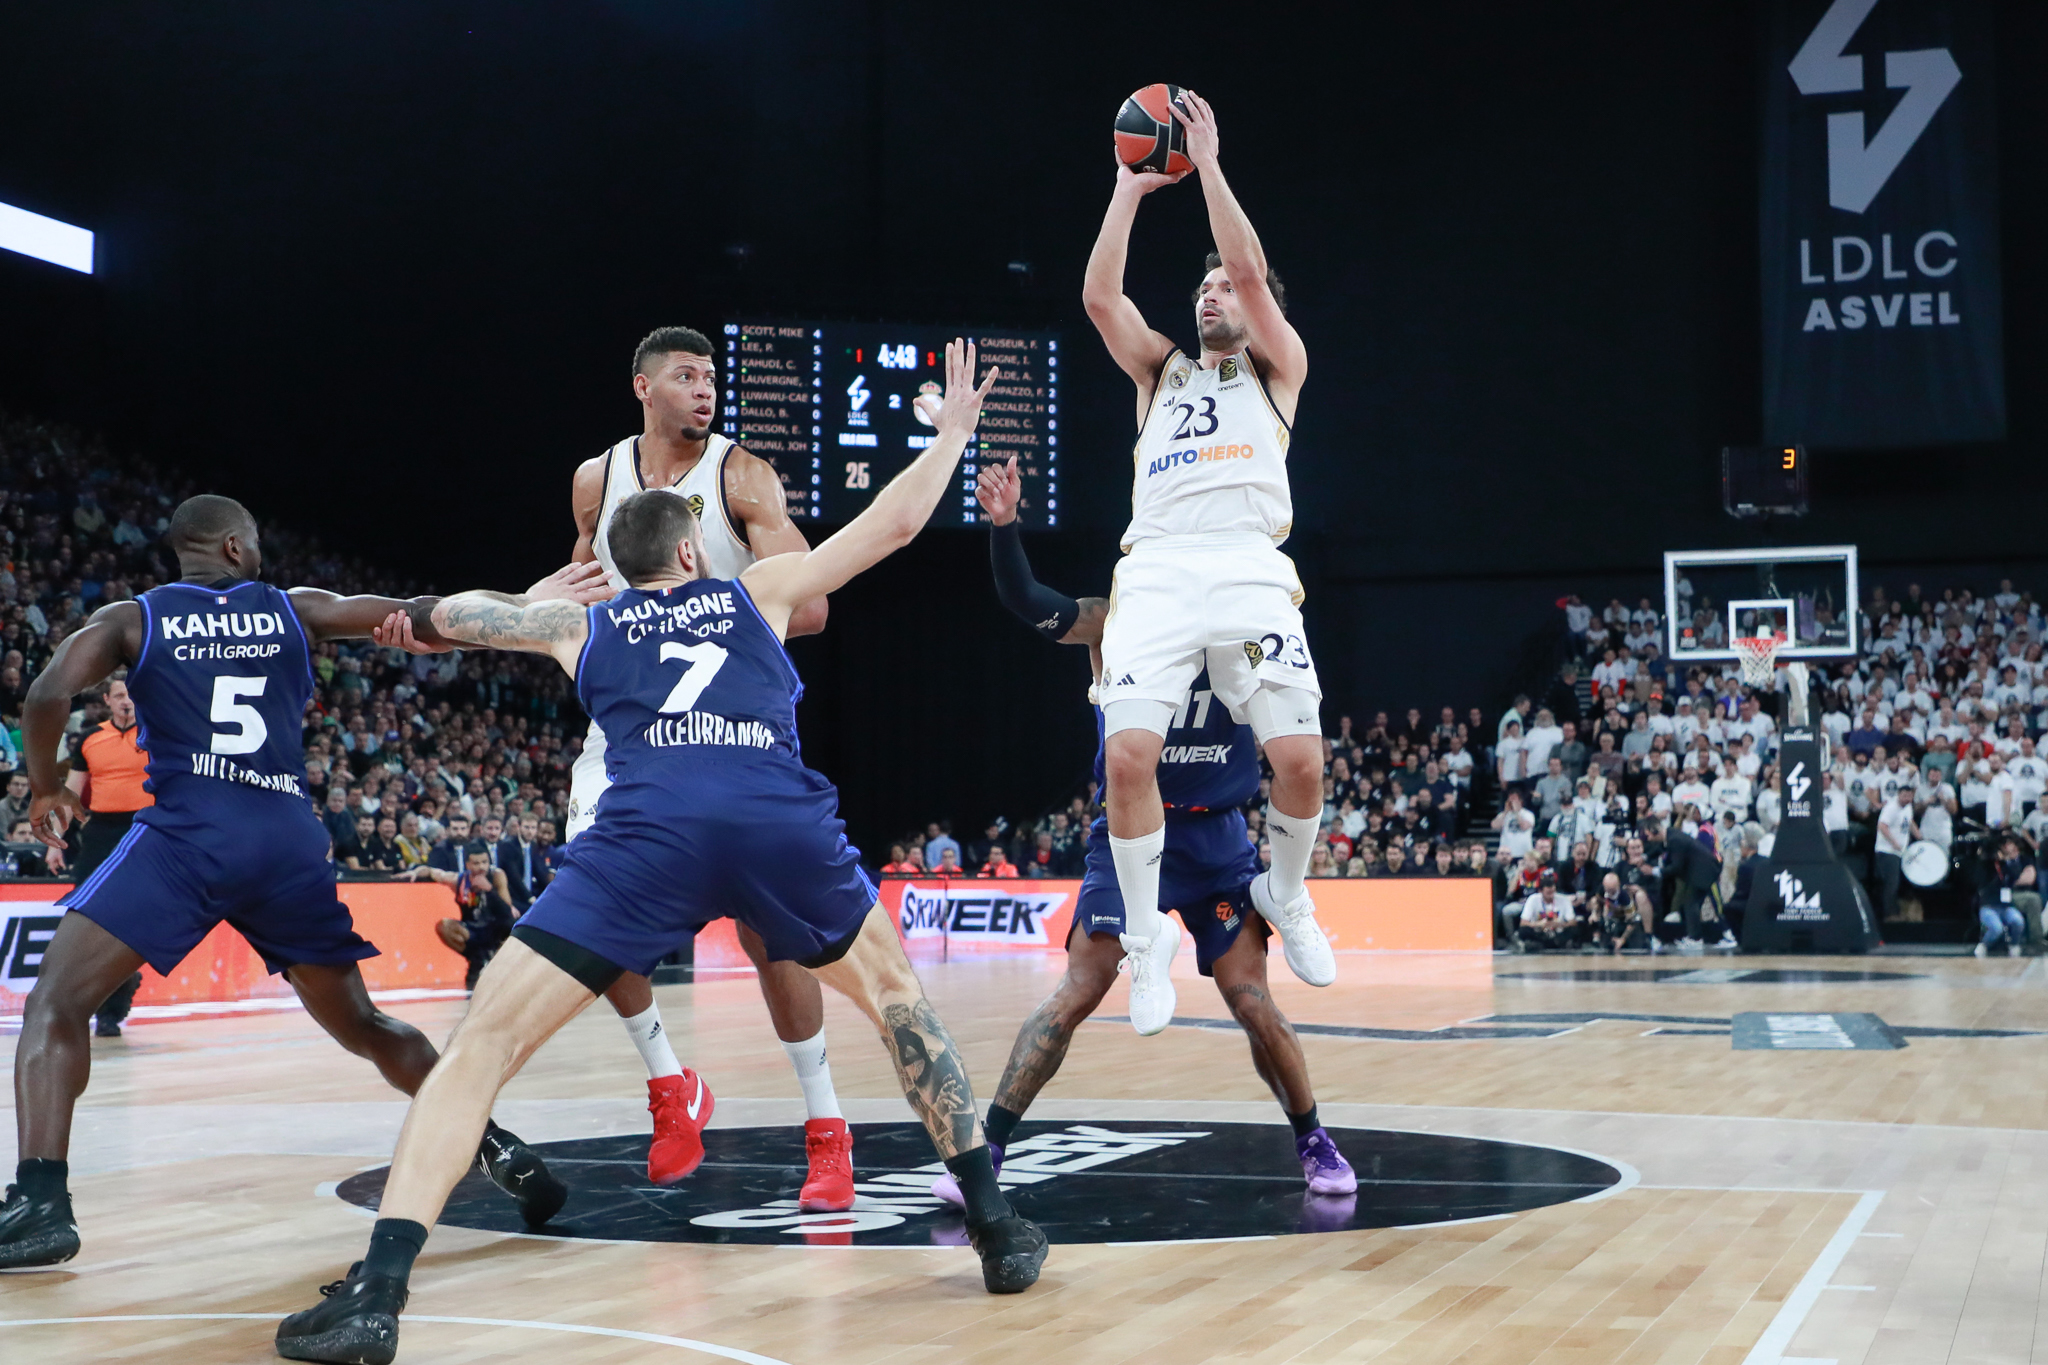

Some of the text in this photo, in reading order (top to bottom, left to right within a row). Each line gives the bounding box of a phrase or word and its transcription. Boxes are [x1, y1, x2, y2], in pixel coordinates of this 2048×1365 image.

[1800, 231, 1958, 285] LDLC
[1802, 291, 1960, 332] ASVEL
[723, 324, 822, 339] 00 SCOTT, MIKE 4
[727, 341, 736, 351] 3
[741, 342, 764, 353] LEE,
[813, 345, 822, 356] 5
[980, 337, 1028, 350] CAUSEUR,
[1048, 341, 1057, 351] 5
[877, 343, 917, 369] 4:43
[980, 354, 1020, 366] DIAGNE,
[1048, 356, 1057, 367] 0
[727, 357, 736, 368] 5
[741, 358, 784, 370] KAHUDI,
[813, 361, 822, 372] 2
[727, 373, 736, 383] 7
[812, 377, 822, 388] 4
[1048, 372, 1057, 383] 3
[726, 389, 735, 400] 9
[812, 393, 821, 404] 6
[1048, 388, 1057, 399] 2
[889, 395, 902, 409] 2
[1048, 404, 1057, 414] 0
[723, 405, 738, 416] 10
[812, 409, 821, 420] 0
[1169, 396, 1219, 442] 23
[723, 422, 736, 432] 11
[740, 423, 788, 435] JACKSON,
[812, 425, 821, 436] 0
[1048, 419, 1057, 430] 0
[980, 433, 1040, 445] RODRIGUEZ,
[1048, 435, 1057, 446] 0
[812, 441, 821, 453] 2
[963, 448, 977, 459] 17
[1048, 452, 1056, 462] 7
[1148, 444, 1254, 478] AUTOHERO
[1782, 448, 1796, 469] 3
[812, 457, 821, 469] 2
[963, 463, 976, 474] 22
[1048, 467, 1056, 477] 4
[811, 474, 821, 485] 0
[845, 461, 870, 489] 25
[963, 480, 1056, 493] 23 2
[811, 490, 821, 501] 0
[811, 506, 821, 517] 0
[1048, 499, 1056, 510] 0
[963, 512, 975, 522] 31
[1048, 514, 1056, 526] 2
[161, 612, 285, 640] KAHUDI
[174, 642, 281, 661] CirilGROUP
[1259, 633, 1310, 670] 23
[657, 641, 729, 714] 7
[209, 675, 268, 755] 5
[902, 891, 1050, 934] SKWEEK
